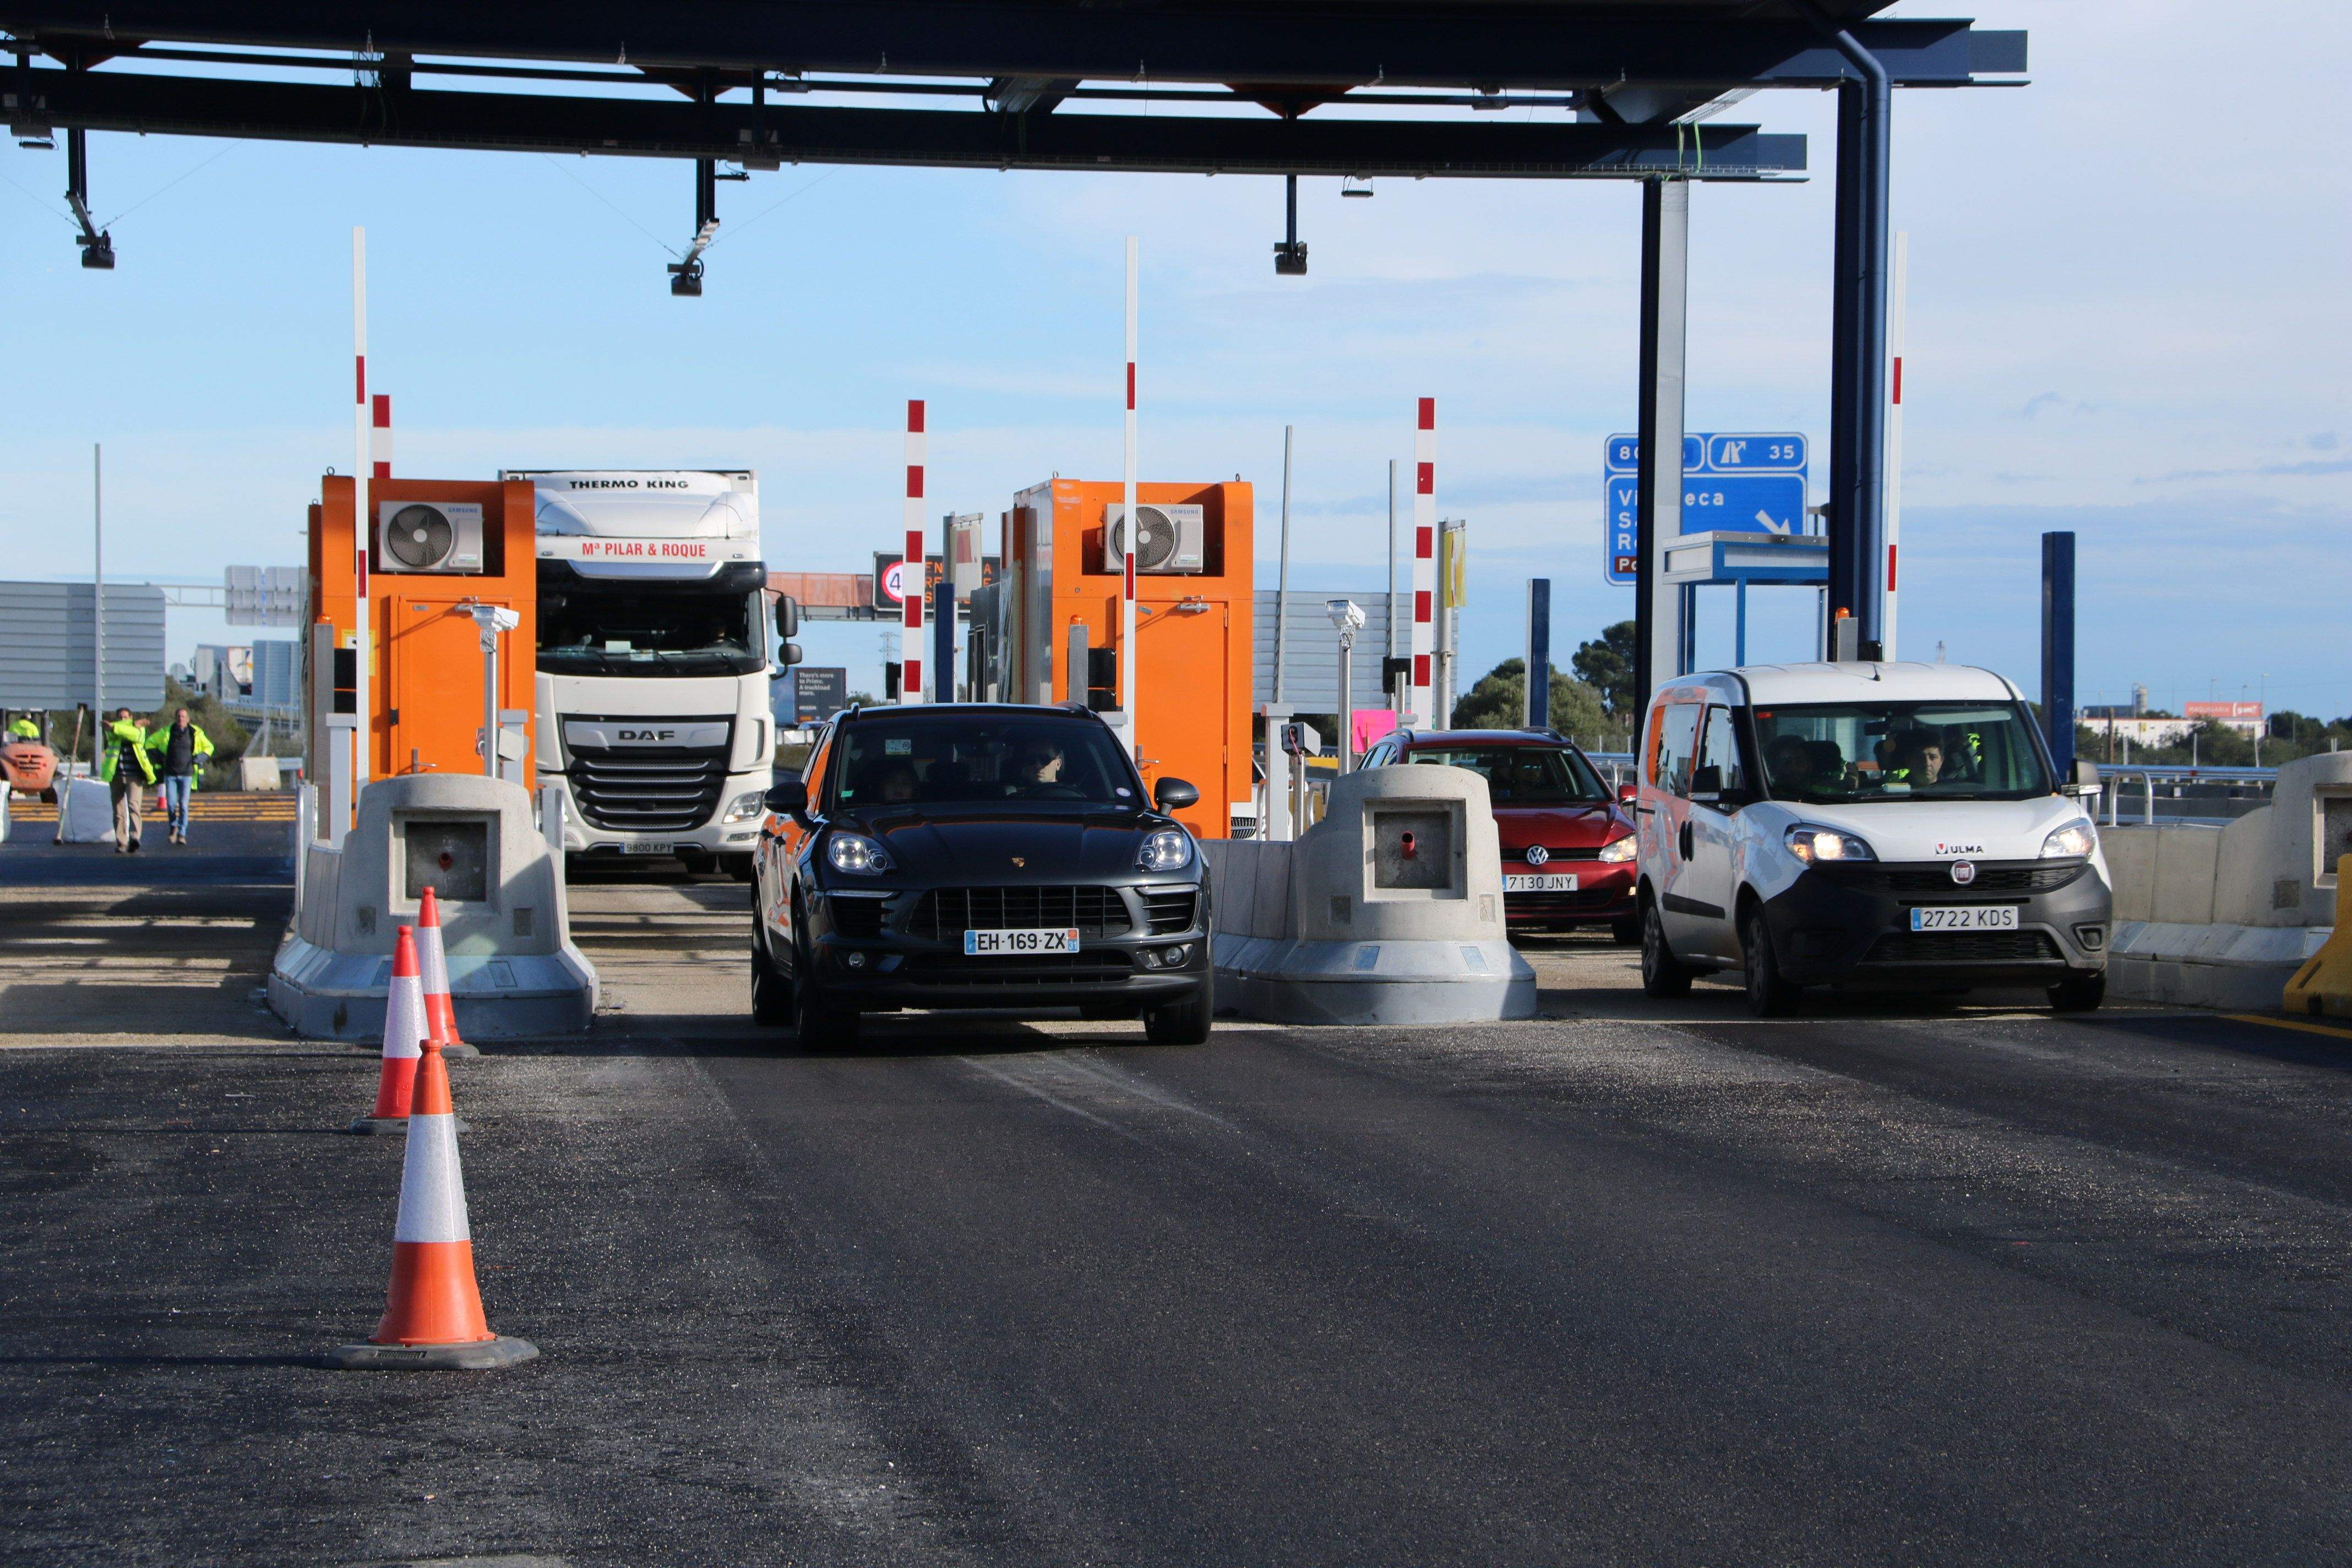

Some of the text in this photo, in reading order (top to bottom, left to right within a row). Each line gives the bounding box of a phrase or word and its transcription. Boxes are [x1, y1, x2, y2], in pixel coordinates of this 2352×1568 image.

[1769, 445, 1795, 460] 35
[569, 480, 689, 489] THERMO KING
[605, 542, 643, 556] PILAR
[648, 543, 657, 556] &
[662, 543, 706, 558] ROQUE
[618, 730, 675, 740] DAF
[627, 844, 672, 852] 9800 KPY
[1956, 867, 1970, 879] FIAT
[1509, 876, 1572, 889] 7130 JNY
[1924, 910, 2012, 927] 2722 KDS
[977, 932, 1065, 951] EH-169-ZX
[1068, 941, 1077, 950] 31
